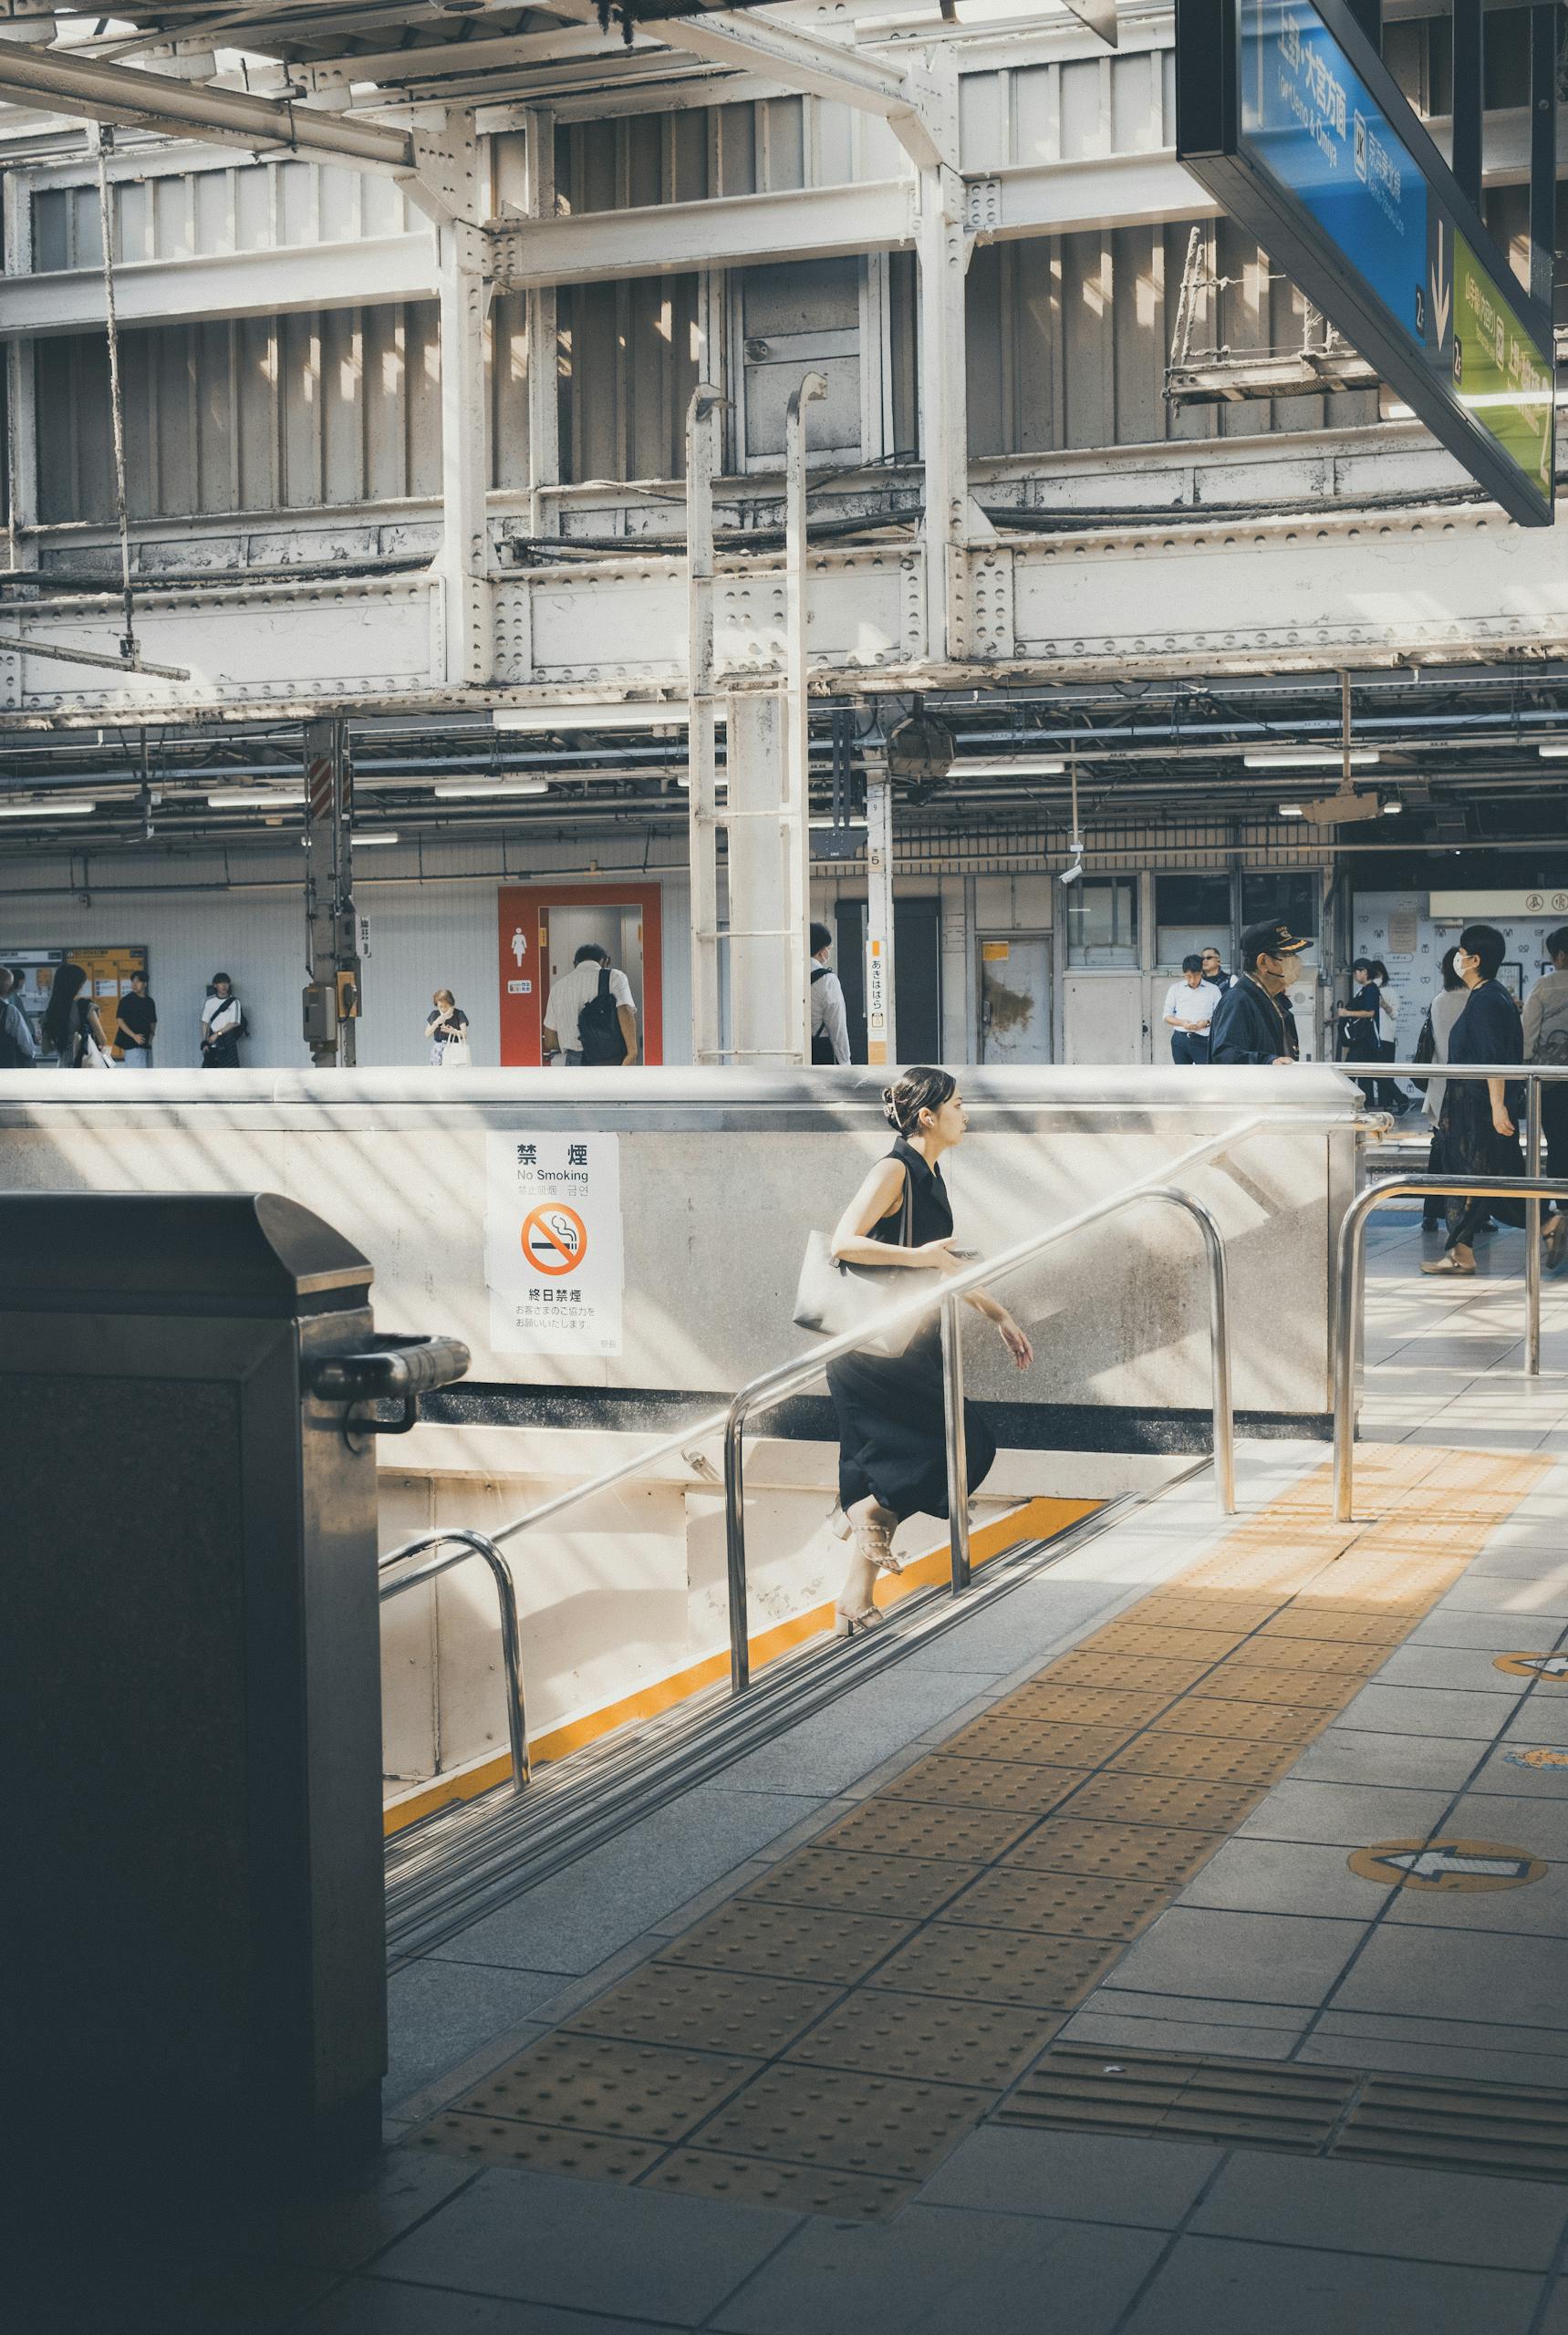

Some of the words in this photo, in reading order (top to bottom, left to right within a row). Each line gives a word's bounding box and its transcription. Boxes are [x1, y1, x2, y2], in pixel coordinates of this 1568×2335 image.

[1277, 13, 1346, 142] 上野・大宮方面
[1291, 87, 1309, 130] Ueno
[1310, 108, 1315, 139] &
[1356, 130, 1364, 162] JK
[871, 856, 879, 866] 5
[517, 1169, 534, 1180] No
[536, 1169, 588, 1183] Smoking
[567, 1186, 588, 1197] 금연
[529, 1288, 582, 1302] 終日禁煙
